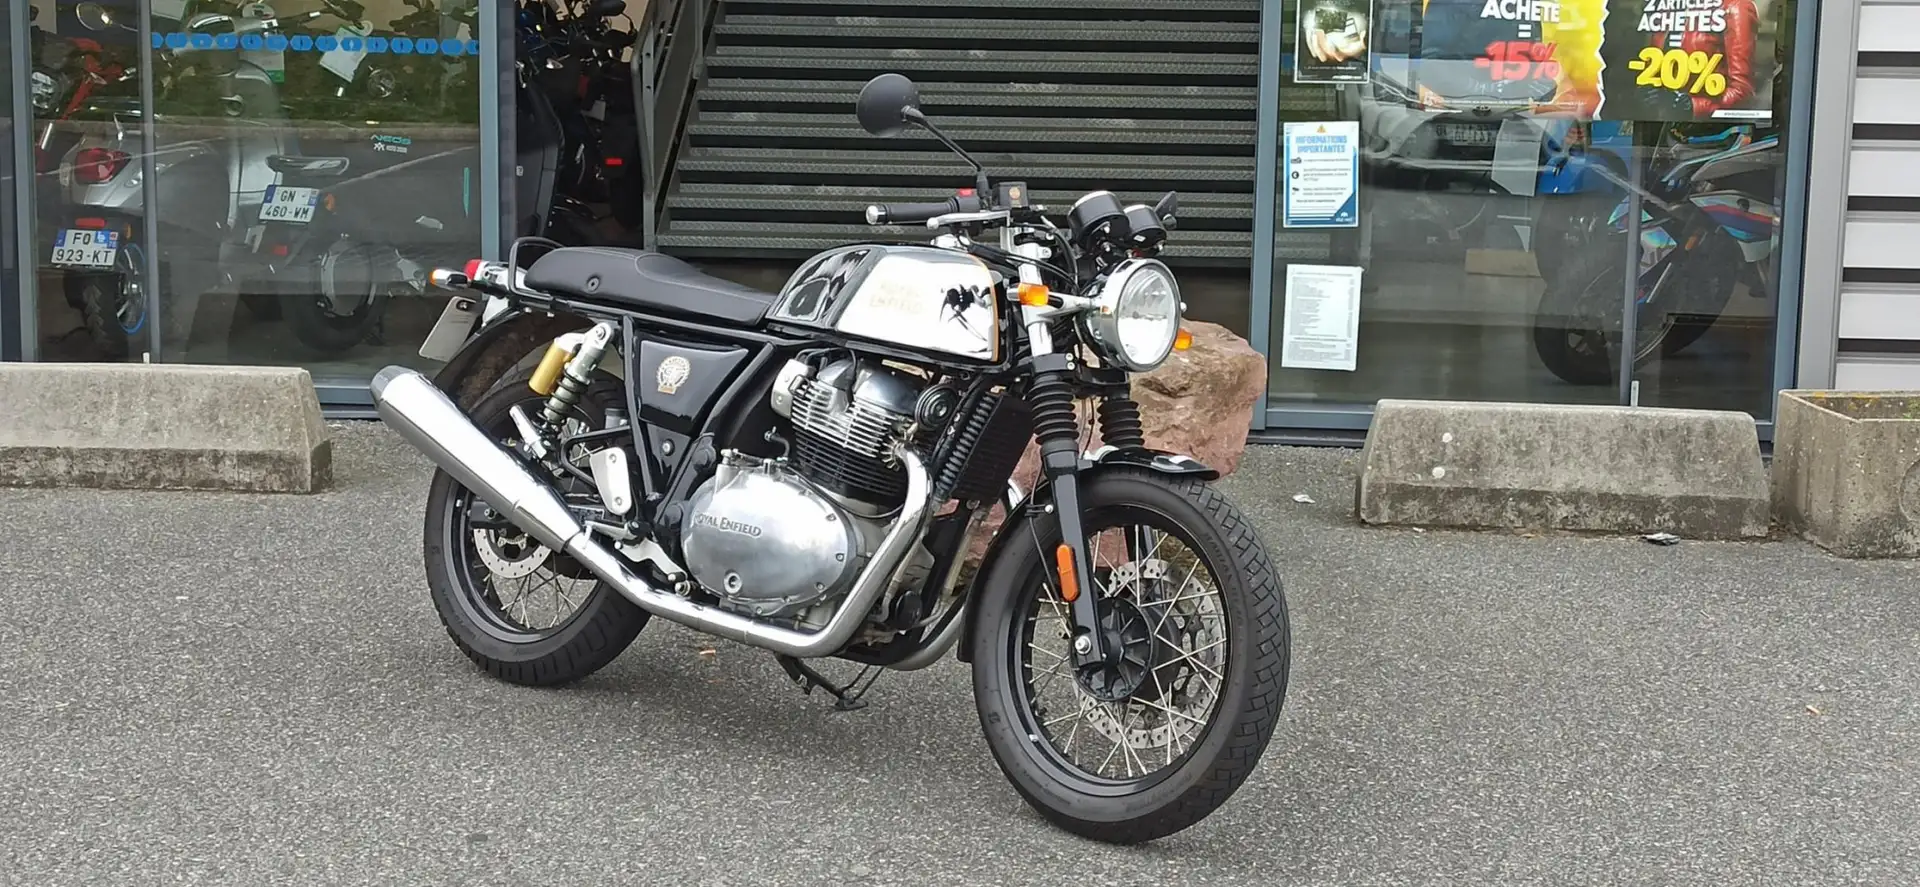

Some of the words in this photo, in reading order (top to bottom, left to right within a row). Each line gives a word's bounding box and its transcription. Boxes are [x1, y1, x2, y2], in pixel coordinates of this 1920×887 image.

[1473, 40, 1562, 81] -15%
[1628, 47, 1726, 96] -20%
[265, 206, 309, 218] 460-WM
[55, 249, 111, 263] 923-KT
